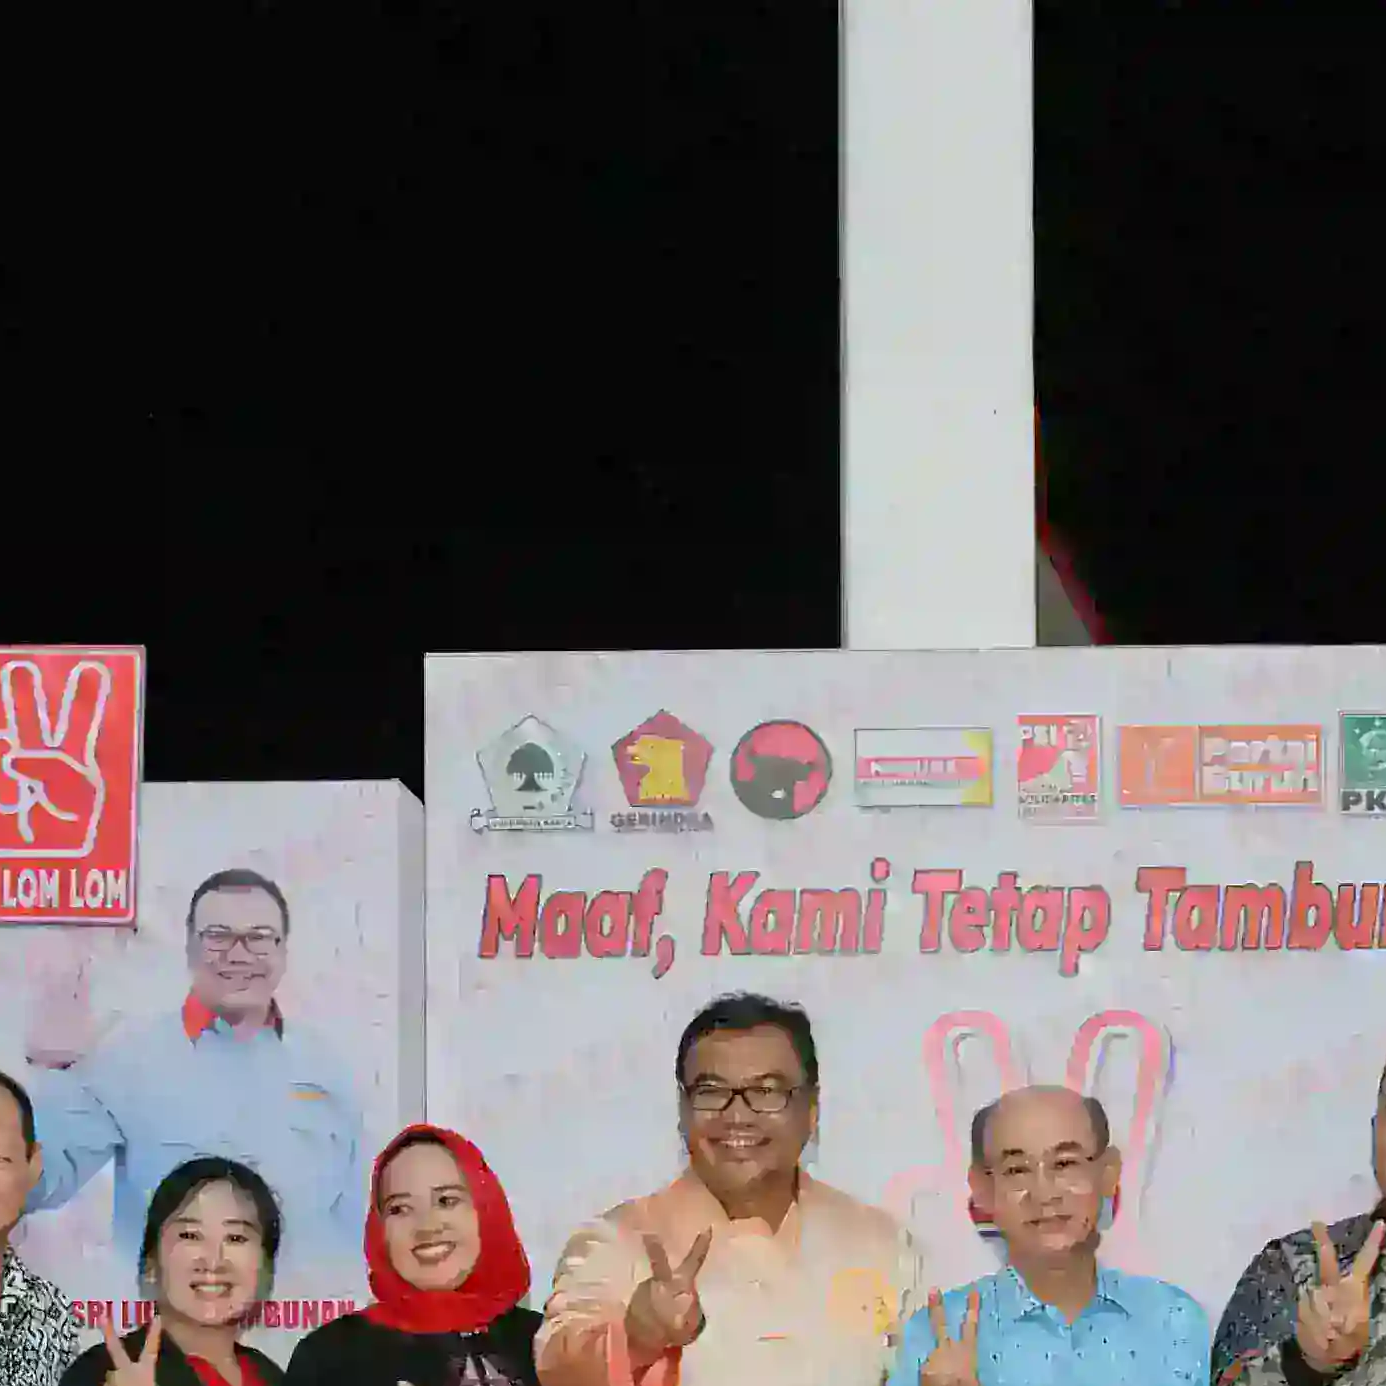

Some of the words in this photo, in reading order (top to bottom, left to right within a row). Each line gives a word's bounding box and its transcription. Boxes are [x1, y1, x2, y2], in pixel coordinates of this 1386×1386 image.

[1, 868, 60, 908] LOM
[69, 868, 128, 909] LOM
[478, 866, 676, 979] Maaf,
[700, 857, 892, 956] Kami
[912, 868, 1113, 977] Tetap
